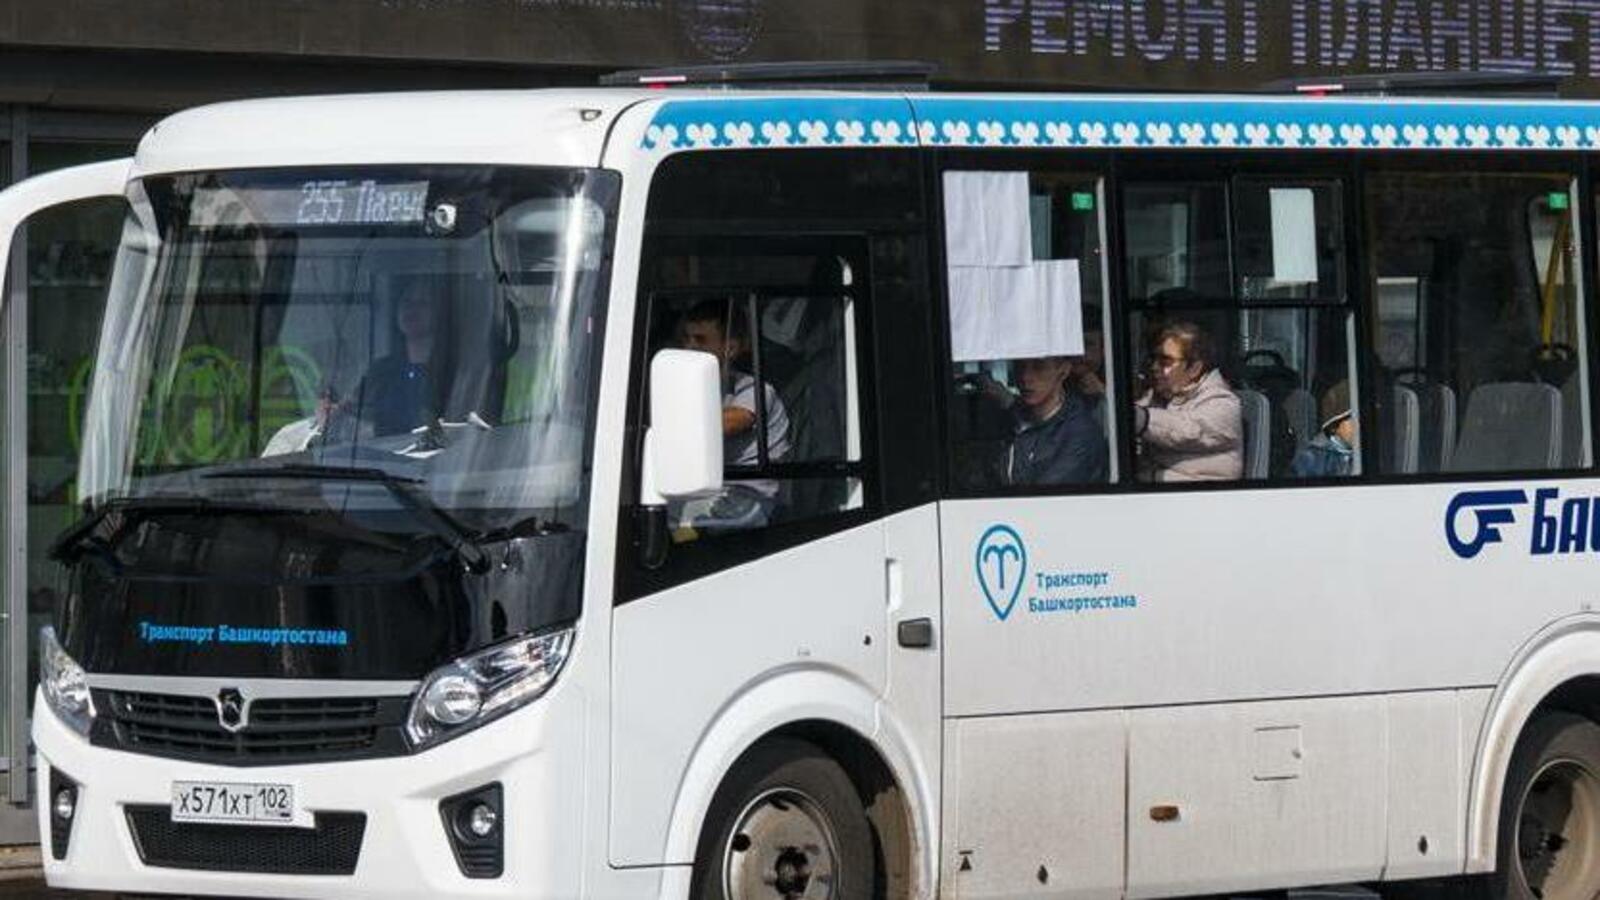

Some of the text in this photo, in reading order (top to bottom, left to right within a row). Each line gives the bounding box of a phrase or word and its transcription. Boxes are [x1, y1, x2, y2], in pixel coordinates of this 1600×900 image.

[297, 180, 347, 224] 255
[1530, 487, 1600, 555] БА
[1035, 571, 1109, 592] Транспорт
[1028, 594, 1137, 614] Башкортостана
[139, 621, 348, 647] Транспорт Башкортостана
[258, 786, 288, 809] 102
